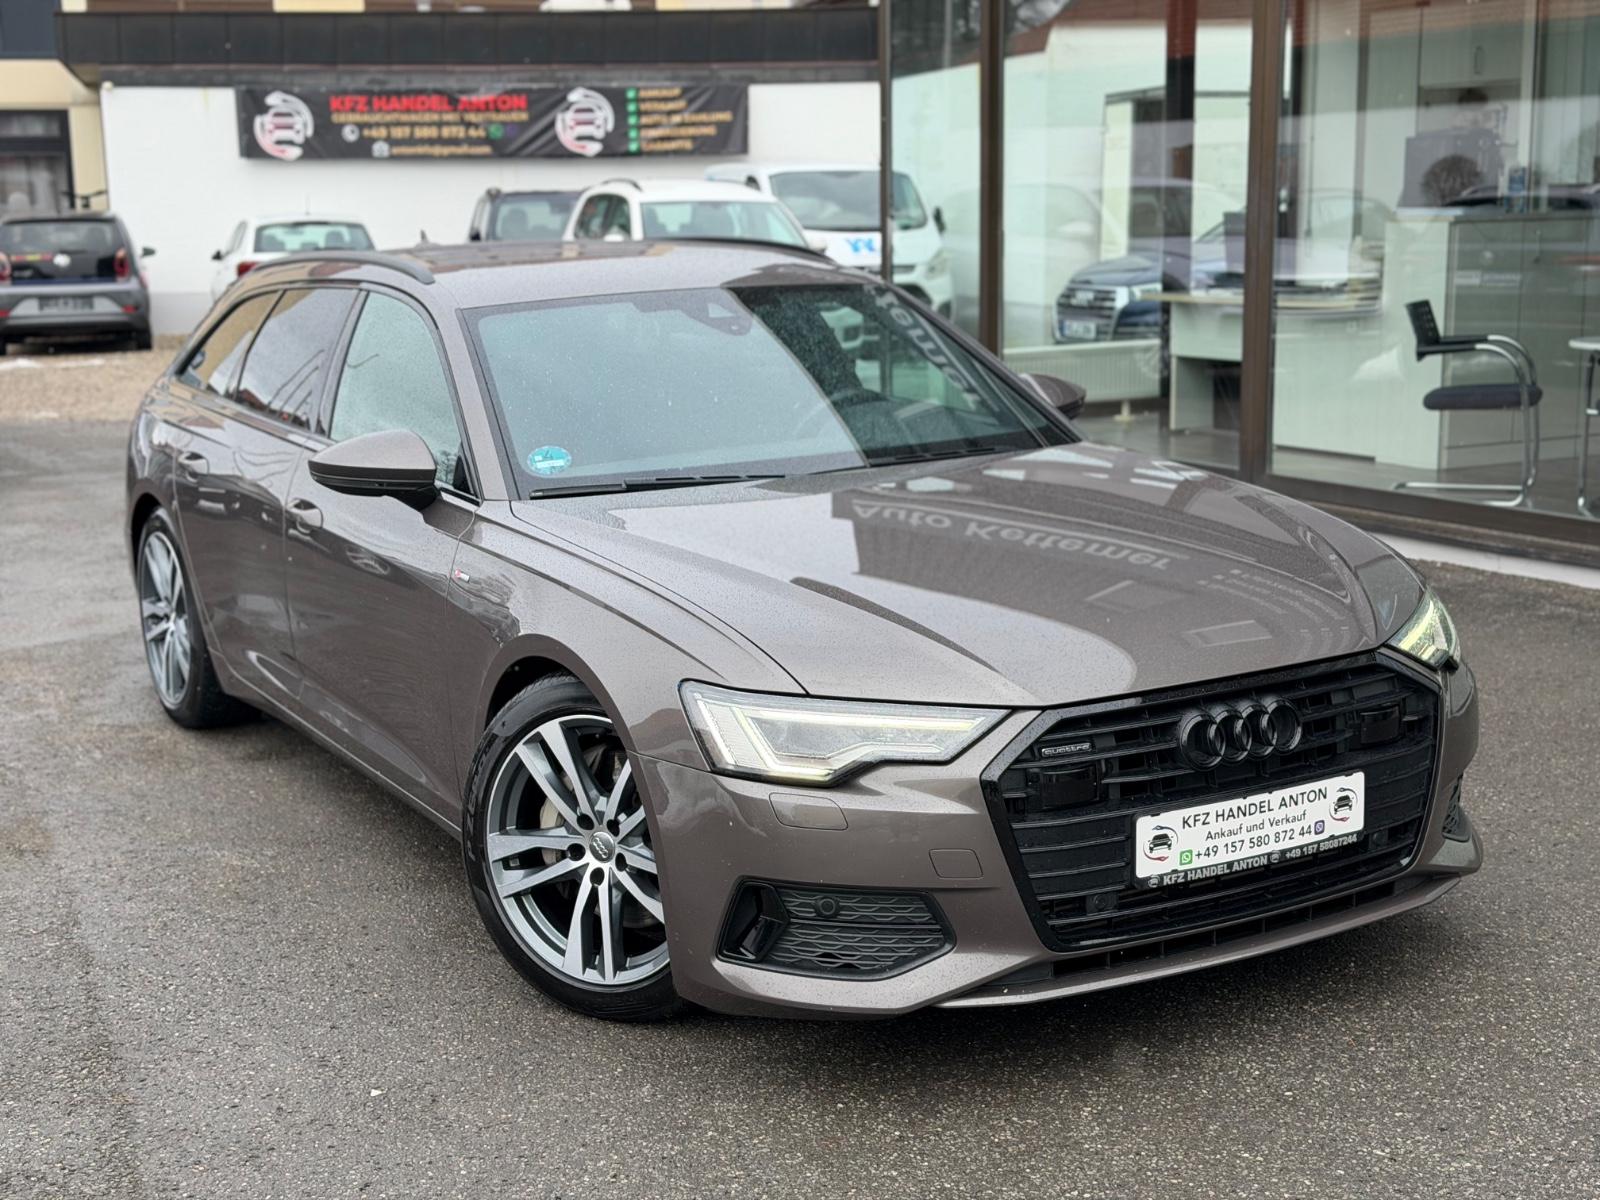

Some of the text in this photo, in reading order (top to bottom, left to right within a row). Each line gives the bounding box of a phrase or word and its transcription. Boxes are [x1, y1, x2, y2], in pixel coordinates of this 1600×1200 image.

[329, 94, 527, 112] KFZ HANDEL ANTON
[1182, 787, 1328, 829] KFZ HANDEL ANTON
[1195, 825, 1312, 859] +49 157 580 872 44
[1205, 810, 1307, 841] Ankauf und Verkauf
[1163, 873, 1185, 885] KFZ
[1188, 865, 1231, 881] HANDEL
[1232, 855, 1268, 872] ANTON
[1285, 848, 1301, 859] +49
[1303, 844, 1318, 855] 157
